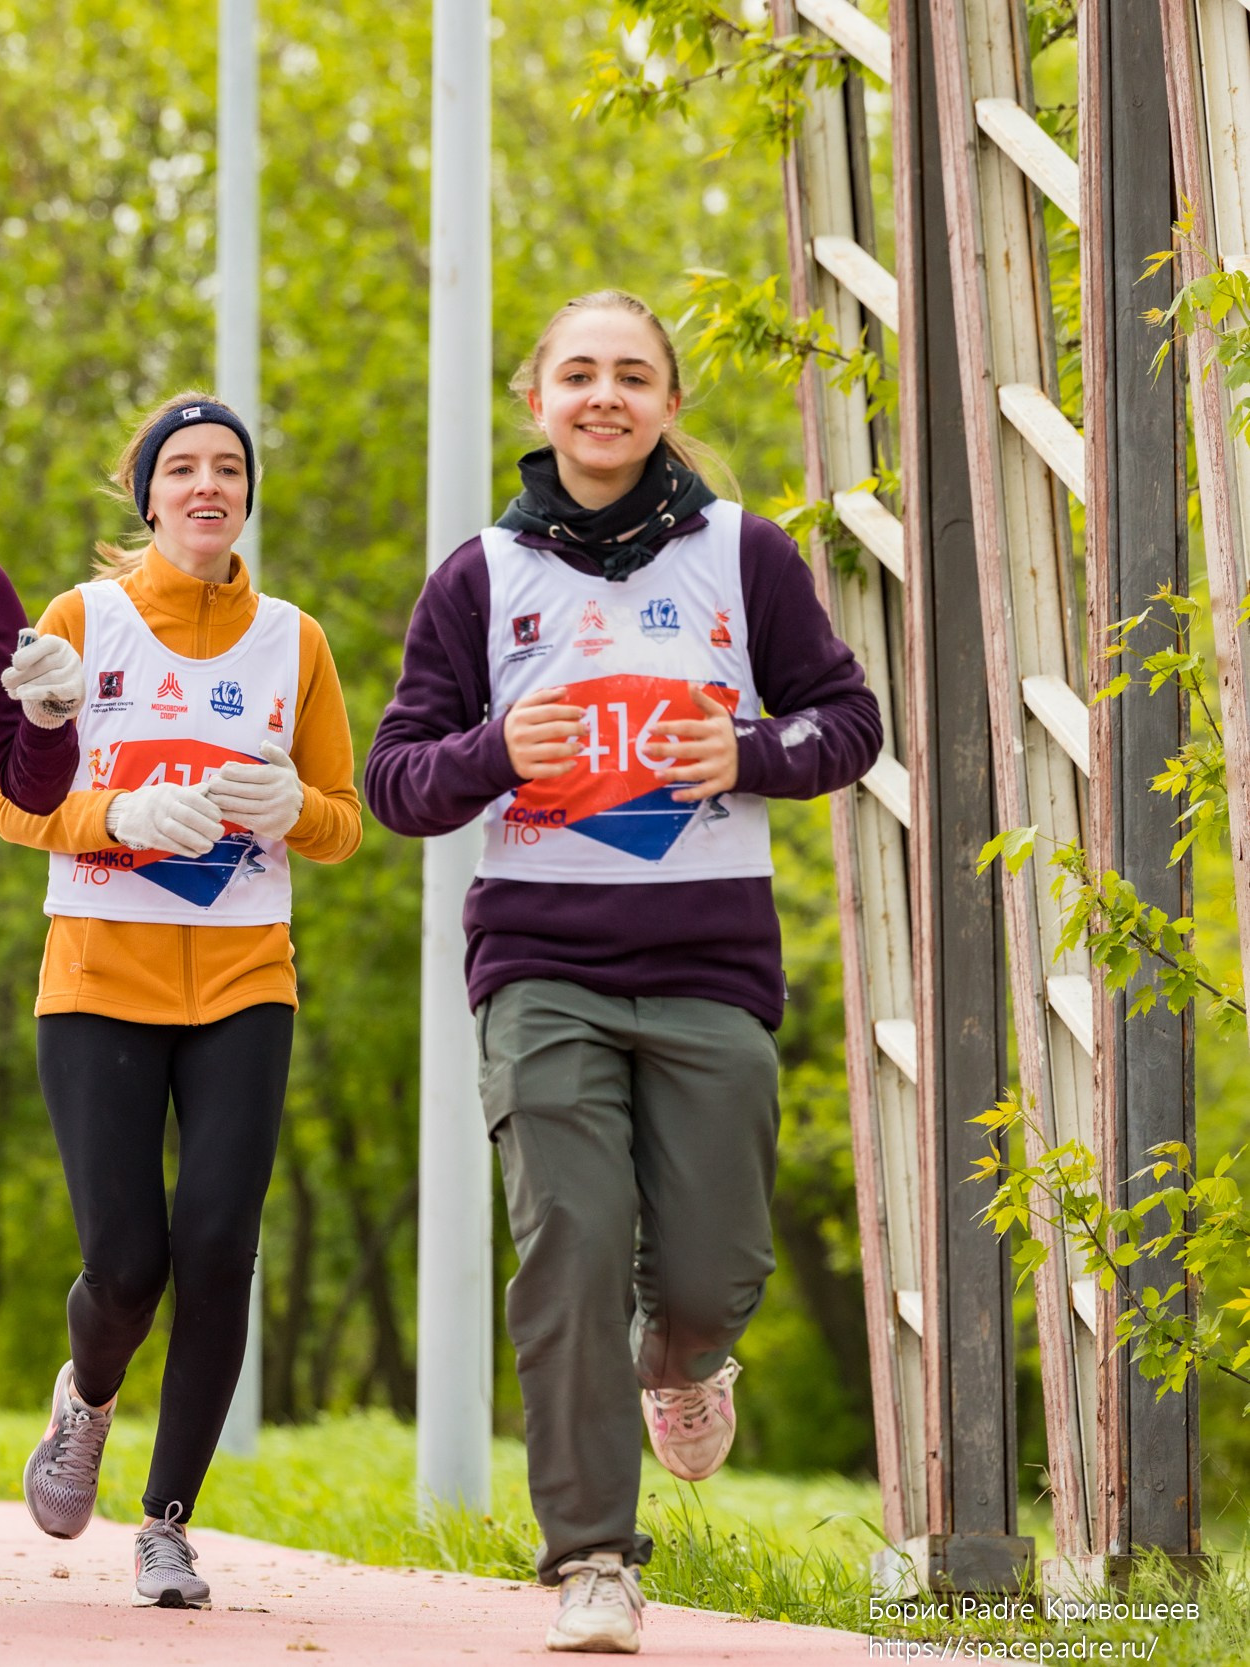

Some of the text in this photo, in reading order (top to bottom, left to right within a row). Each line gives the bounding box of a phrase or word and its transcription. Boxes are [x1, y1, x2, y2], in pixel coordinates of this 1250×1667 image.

[151, 702, 189, 713] МОСКОВСКИЙ
[160, 711, 178, 720] СПОРТ
[565, 700, 679, 774] 416
[504, 823, 541, 846] ГТО
[73, 864, 111, 886] ГТО
